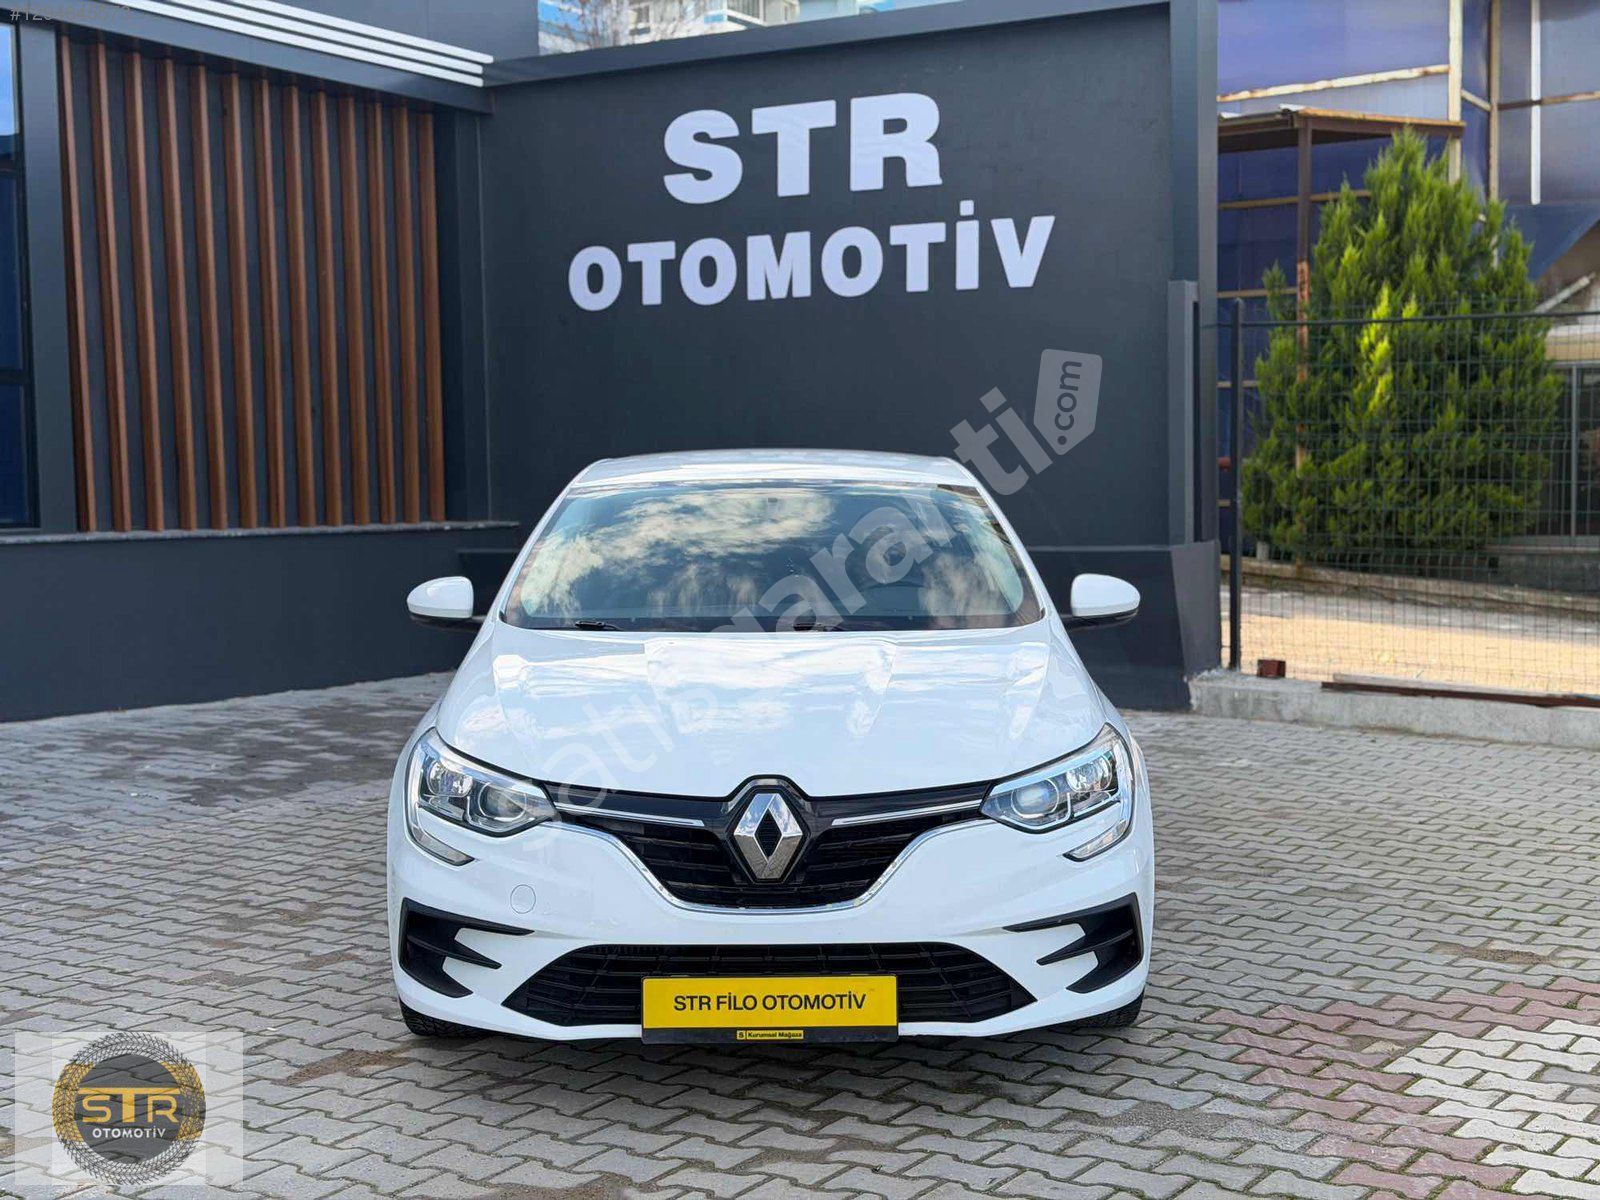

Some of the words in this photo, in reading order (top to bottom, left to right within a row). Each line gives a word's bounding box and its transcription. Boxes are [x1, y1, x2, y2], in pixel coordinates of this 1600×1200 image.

[663, 92, 942, 205] STR
[568, 200, 1056, 311] OTOMOTİV
[673, 995, 711, 1011] STR
[717, 992, 757, 1011] FİLO
[762, 991, 867, 1010] OTOMOTİV
